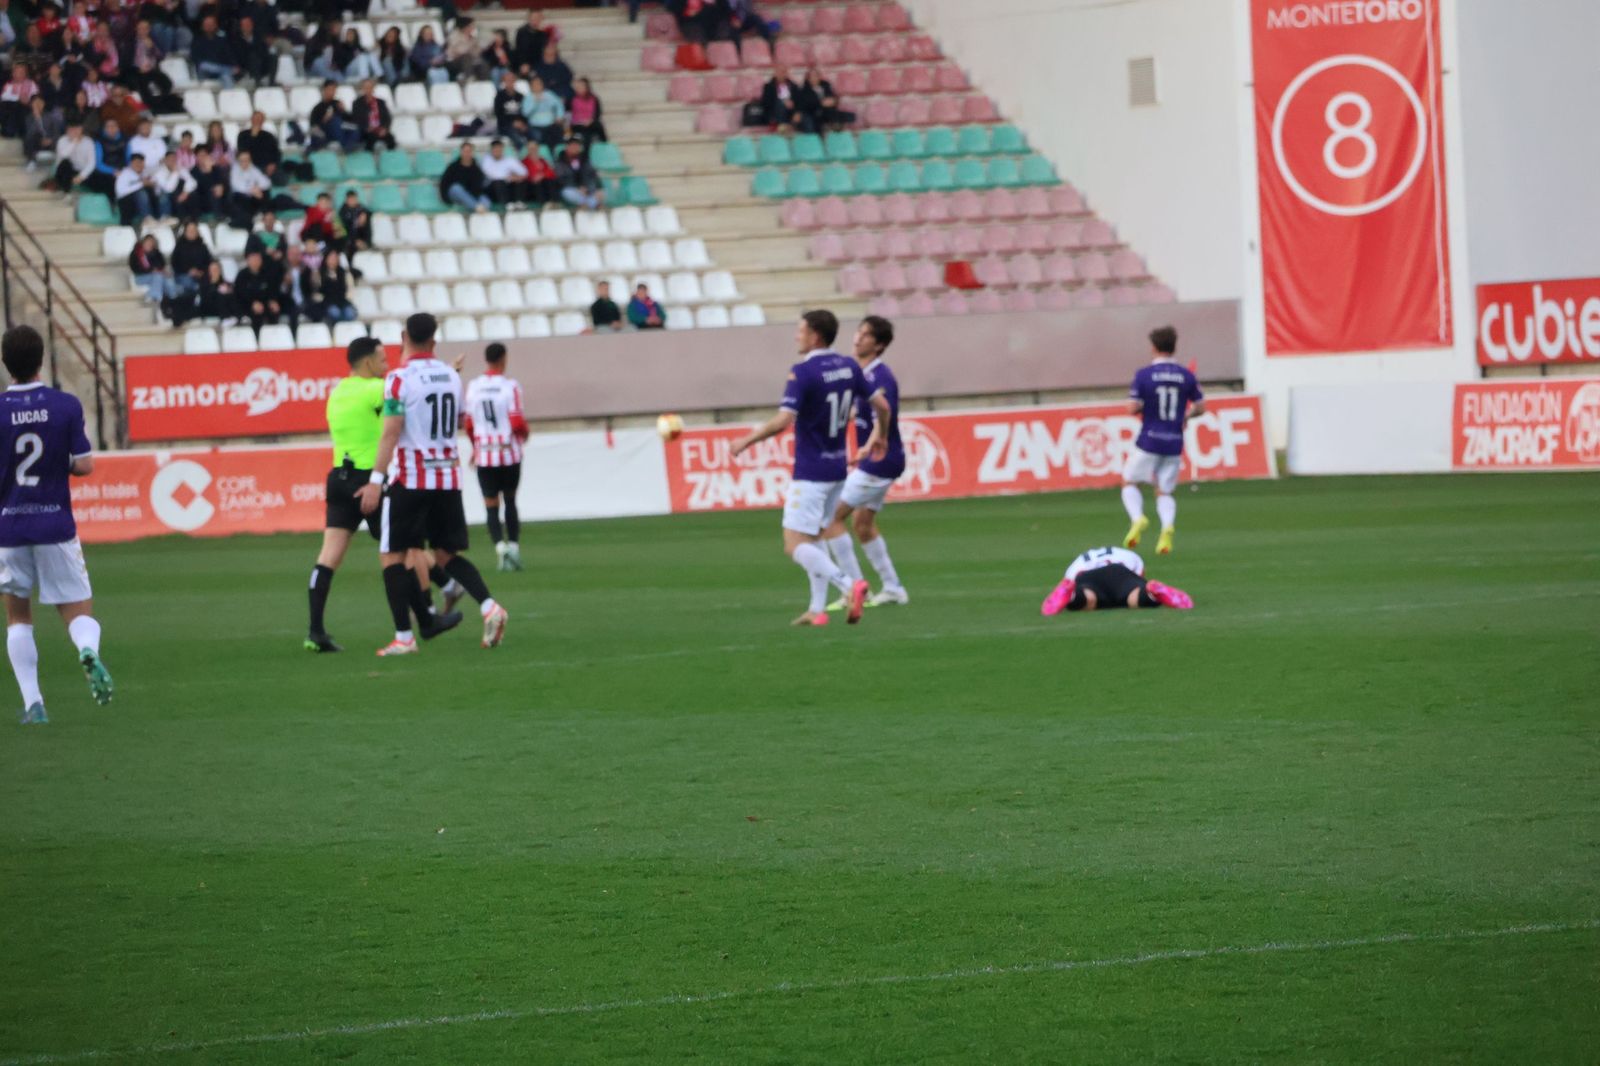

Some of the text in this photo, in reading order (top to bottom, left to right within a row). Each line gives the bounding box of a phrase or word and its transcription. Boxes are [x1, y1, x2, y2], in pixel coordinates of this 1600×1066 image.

[1267, 0, 1422, 29] MONTETORO
[1323, 92, 1377, 179] 8
[11, 408, 49, 425] LUCAS
[425, 393, 455, 440] 10
[482, 400, 498, 429] 4
[1156, 385, 1178, 421] 11
[1463, 383, 1562, 424] FUNDACIÓN
[15, 432, 43, 487] 2
